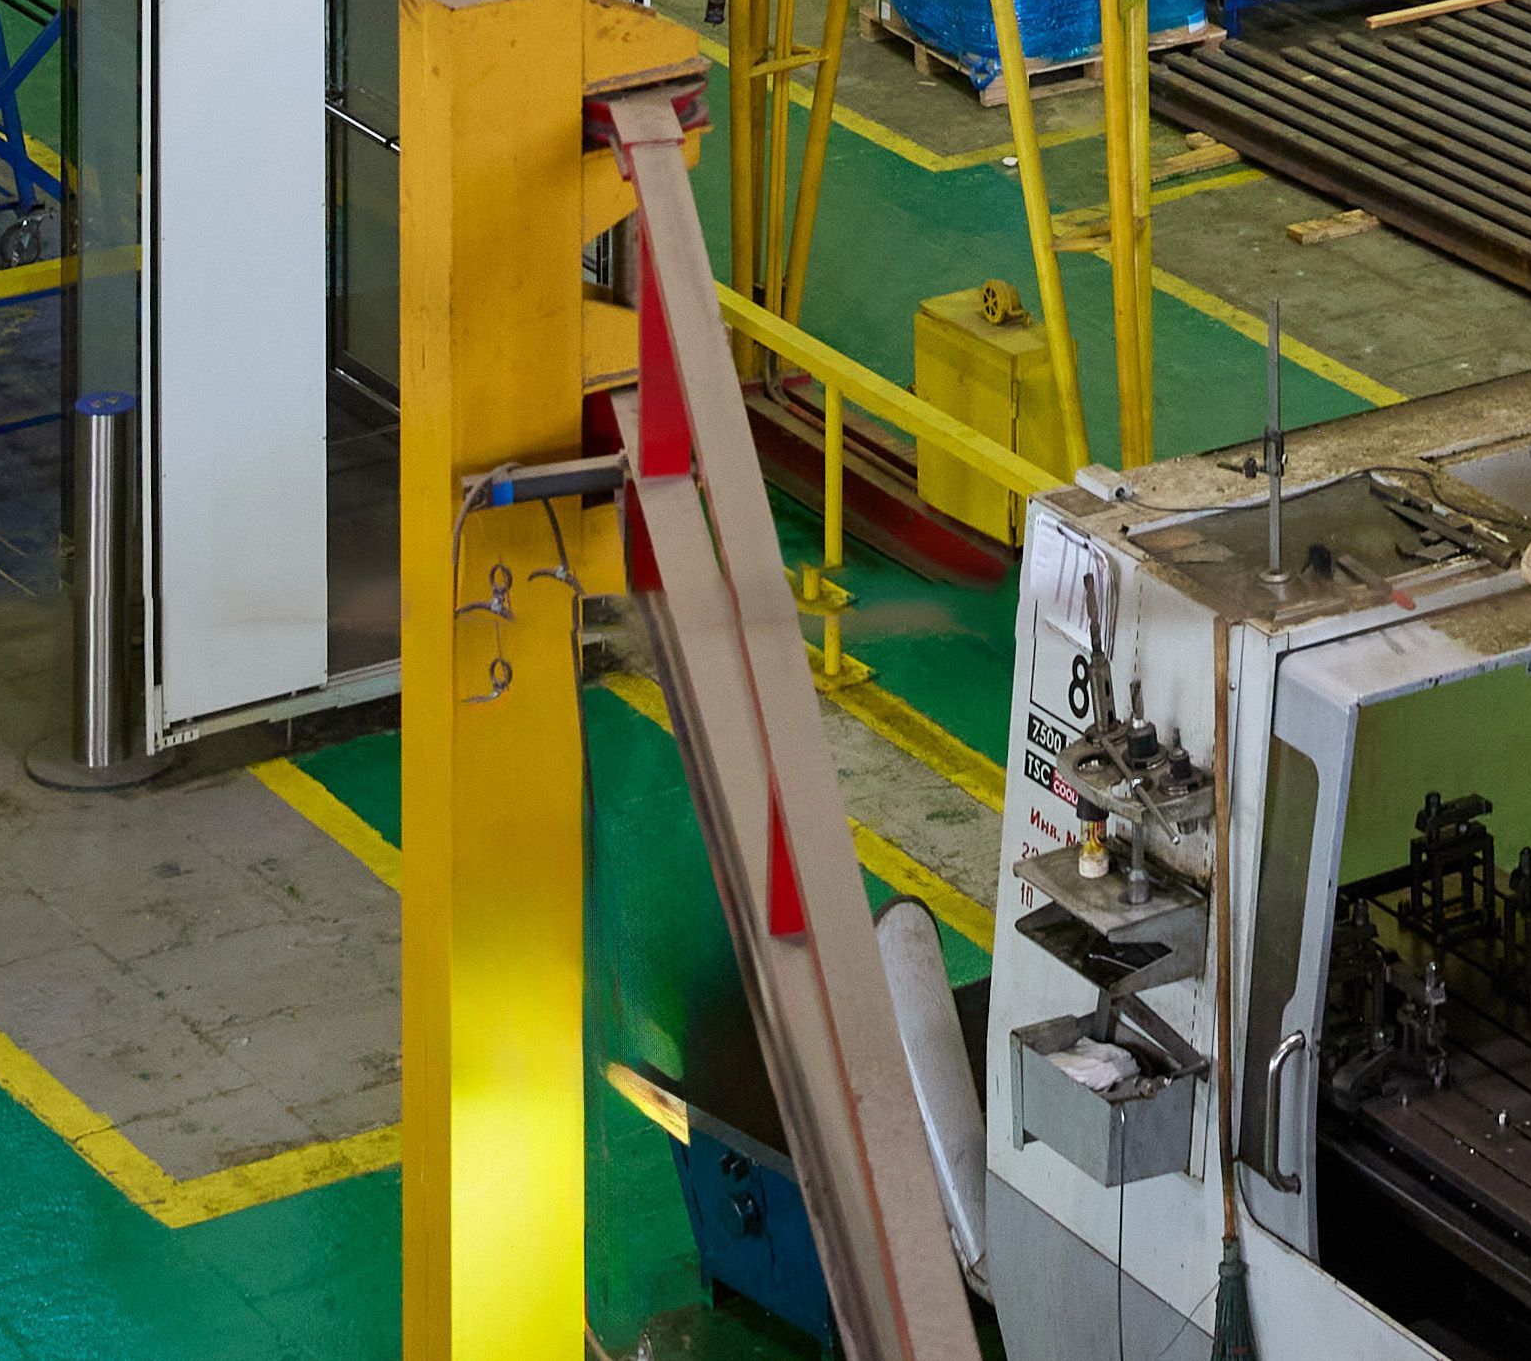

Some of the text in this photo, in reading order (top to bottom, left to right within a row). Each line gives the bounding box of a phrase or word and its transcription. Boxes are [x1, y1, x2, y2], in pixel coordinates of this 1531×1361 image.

[1068, 654, 1091, 719] 8
[1031, 719, 1062, 753] 7,500
[1028, 753, 1051, 787] TSC
[1030, 807, 1061, 843] Инв.
